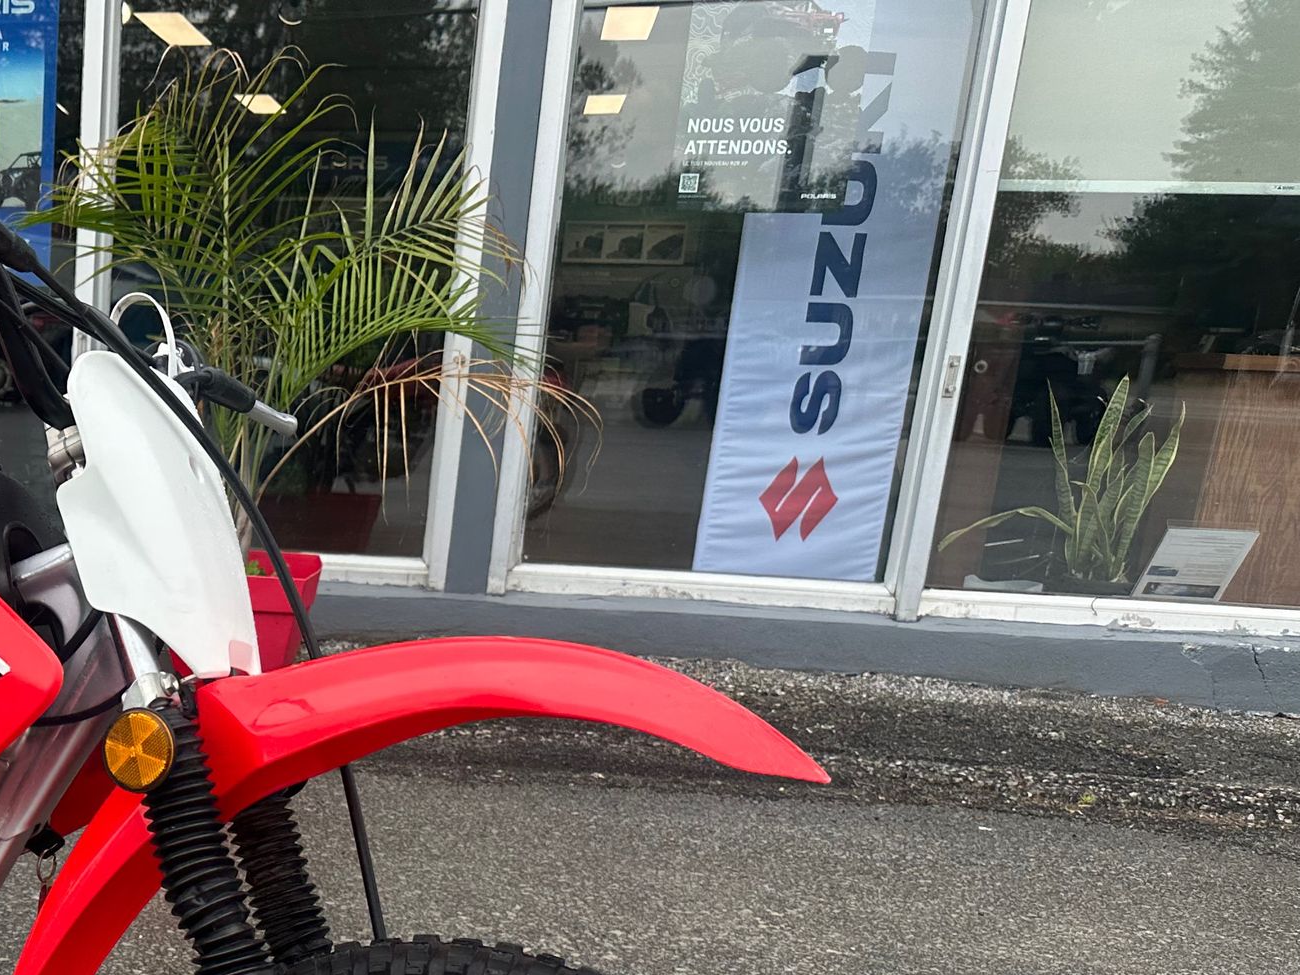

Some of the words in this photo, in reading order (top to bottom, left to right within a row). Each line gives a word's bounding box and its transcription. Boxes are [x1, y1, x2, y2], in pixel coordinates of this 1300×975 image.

[687, 118, 735, 133] NOUS
[739, 118, 785, 133] VOUS
[684, 139, 792, 155] ATTENDONS.
